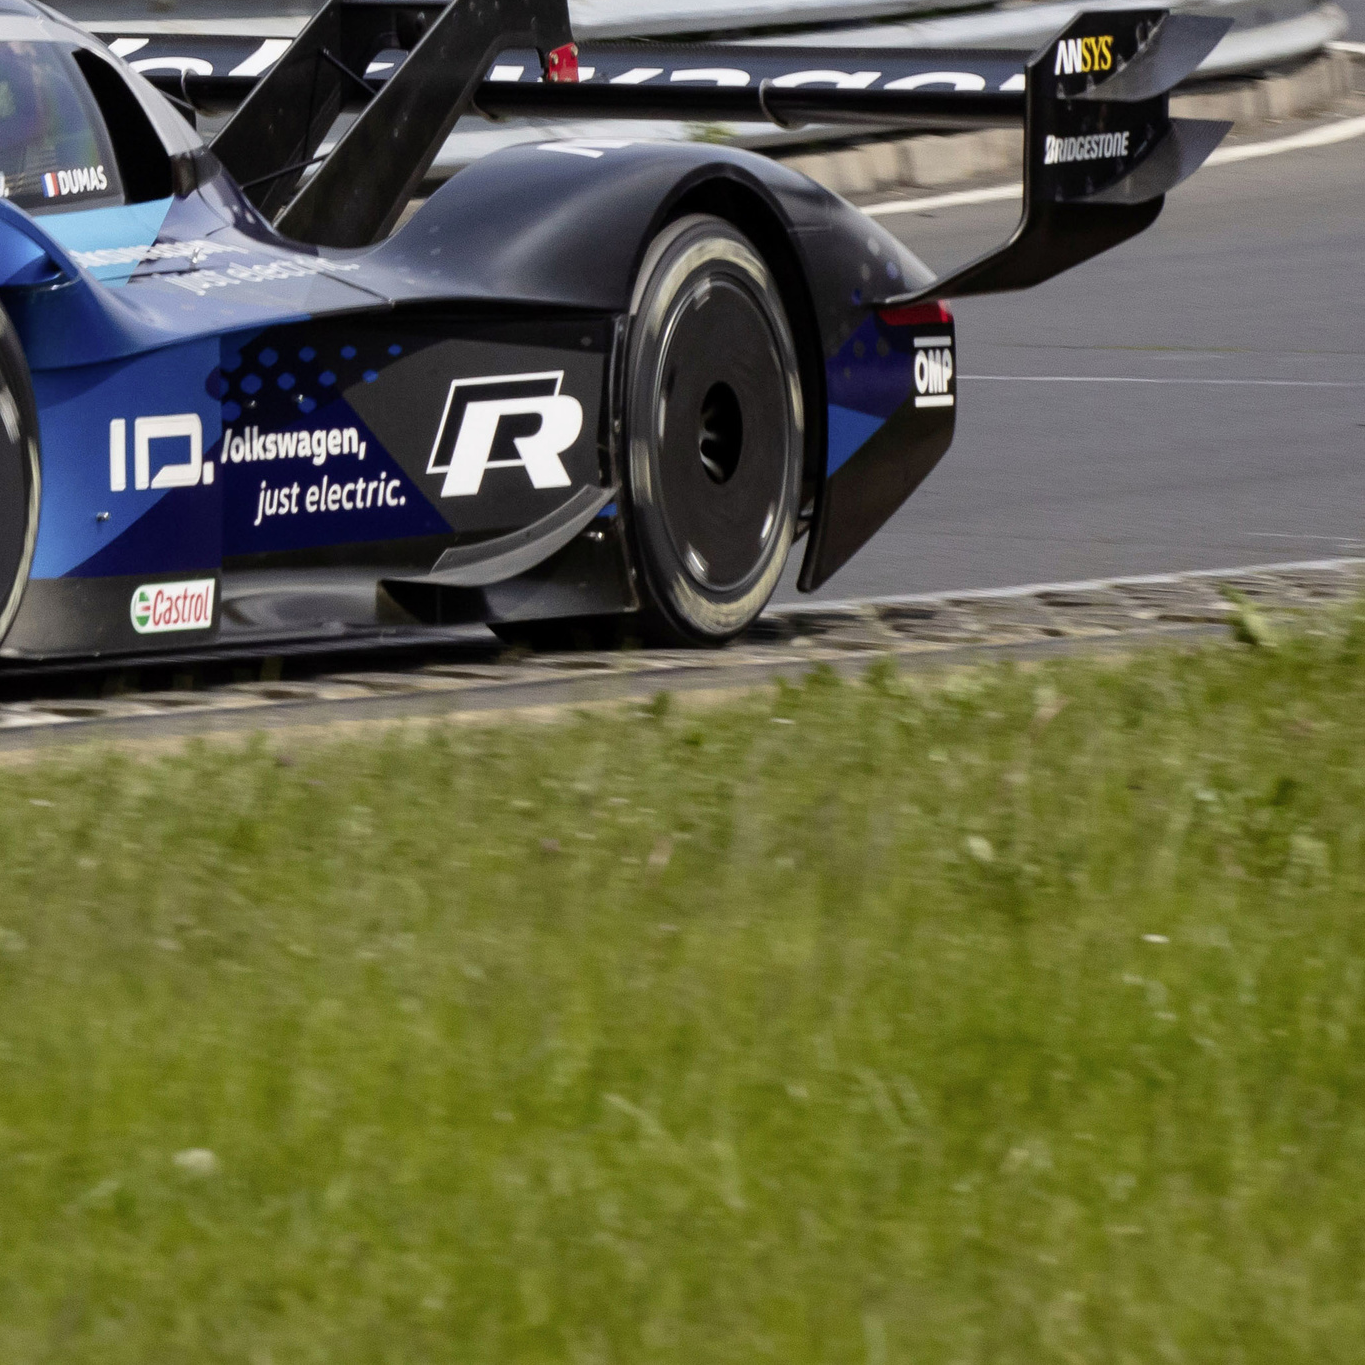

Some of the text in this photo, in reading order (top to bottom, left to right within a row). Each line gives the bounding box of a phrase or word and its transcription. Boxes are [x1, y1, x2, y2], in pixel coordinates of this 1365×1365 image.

[1054, 35, 1113, 75] ANSYS
[1044, 131, 1130, 165] BRIDGESTONE
[57, 164, 108, 197] DUMAS
[914, 348, 953, 395] OMP
[429, 382, 584, 499] R
[254, 471, 406, 526] just electric.
[152, 585, 210, 627] Castrol
